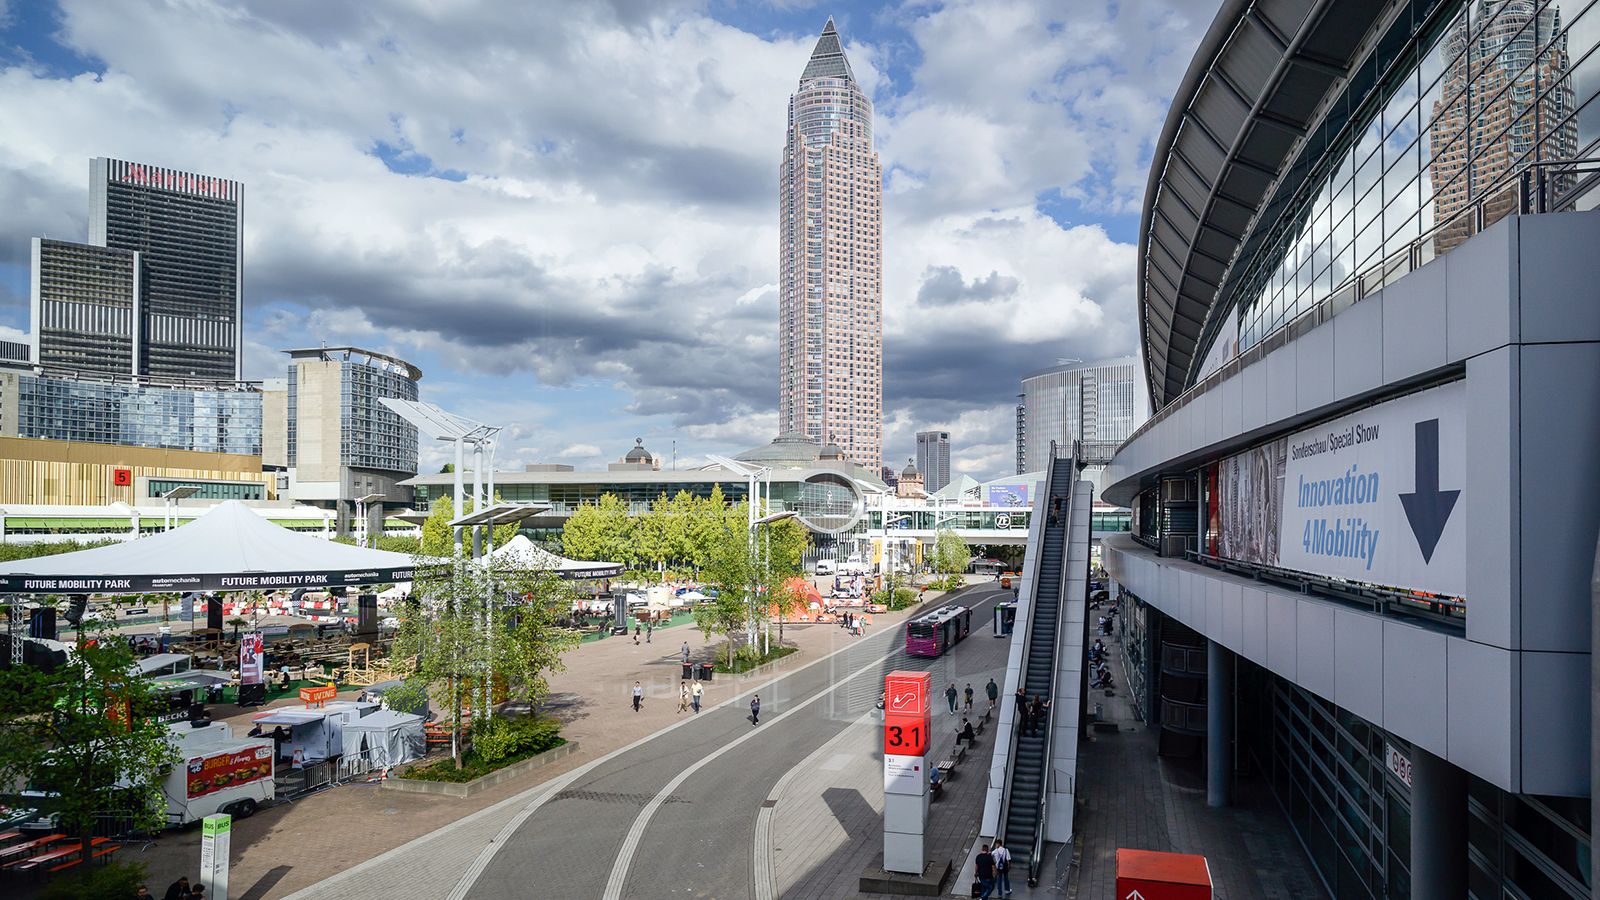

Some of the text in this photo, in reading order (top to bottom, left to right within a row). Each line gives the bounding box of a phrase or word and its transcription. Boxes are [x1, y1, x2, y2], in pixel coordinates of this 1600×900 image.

[122, 162, 227, 196] Marriott
[1355, 423, 1380, 444] Show
[119, 472, 126, 482] 5
[1298, 464, 1379, 507] Innovation
[221, 574, 328, 586] FUTURE MOBILITY PARK
[344, 571, 379, 579] automechanika
[392, 571, 414, 579] FUTURE
[24, 579, 131, 589] FUTURE MOBILITY PARK
[313, 689, 335, 700] WINE
[157, 711, 189, 723] BECK'S
[889, 726, 919, 747] 3.1
[204, 755, 230, 770] BURGER
[204, 822, 214, 830] BUS
[217, 820, 230, 829] BUS
